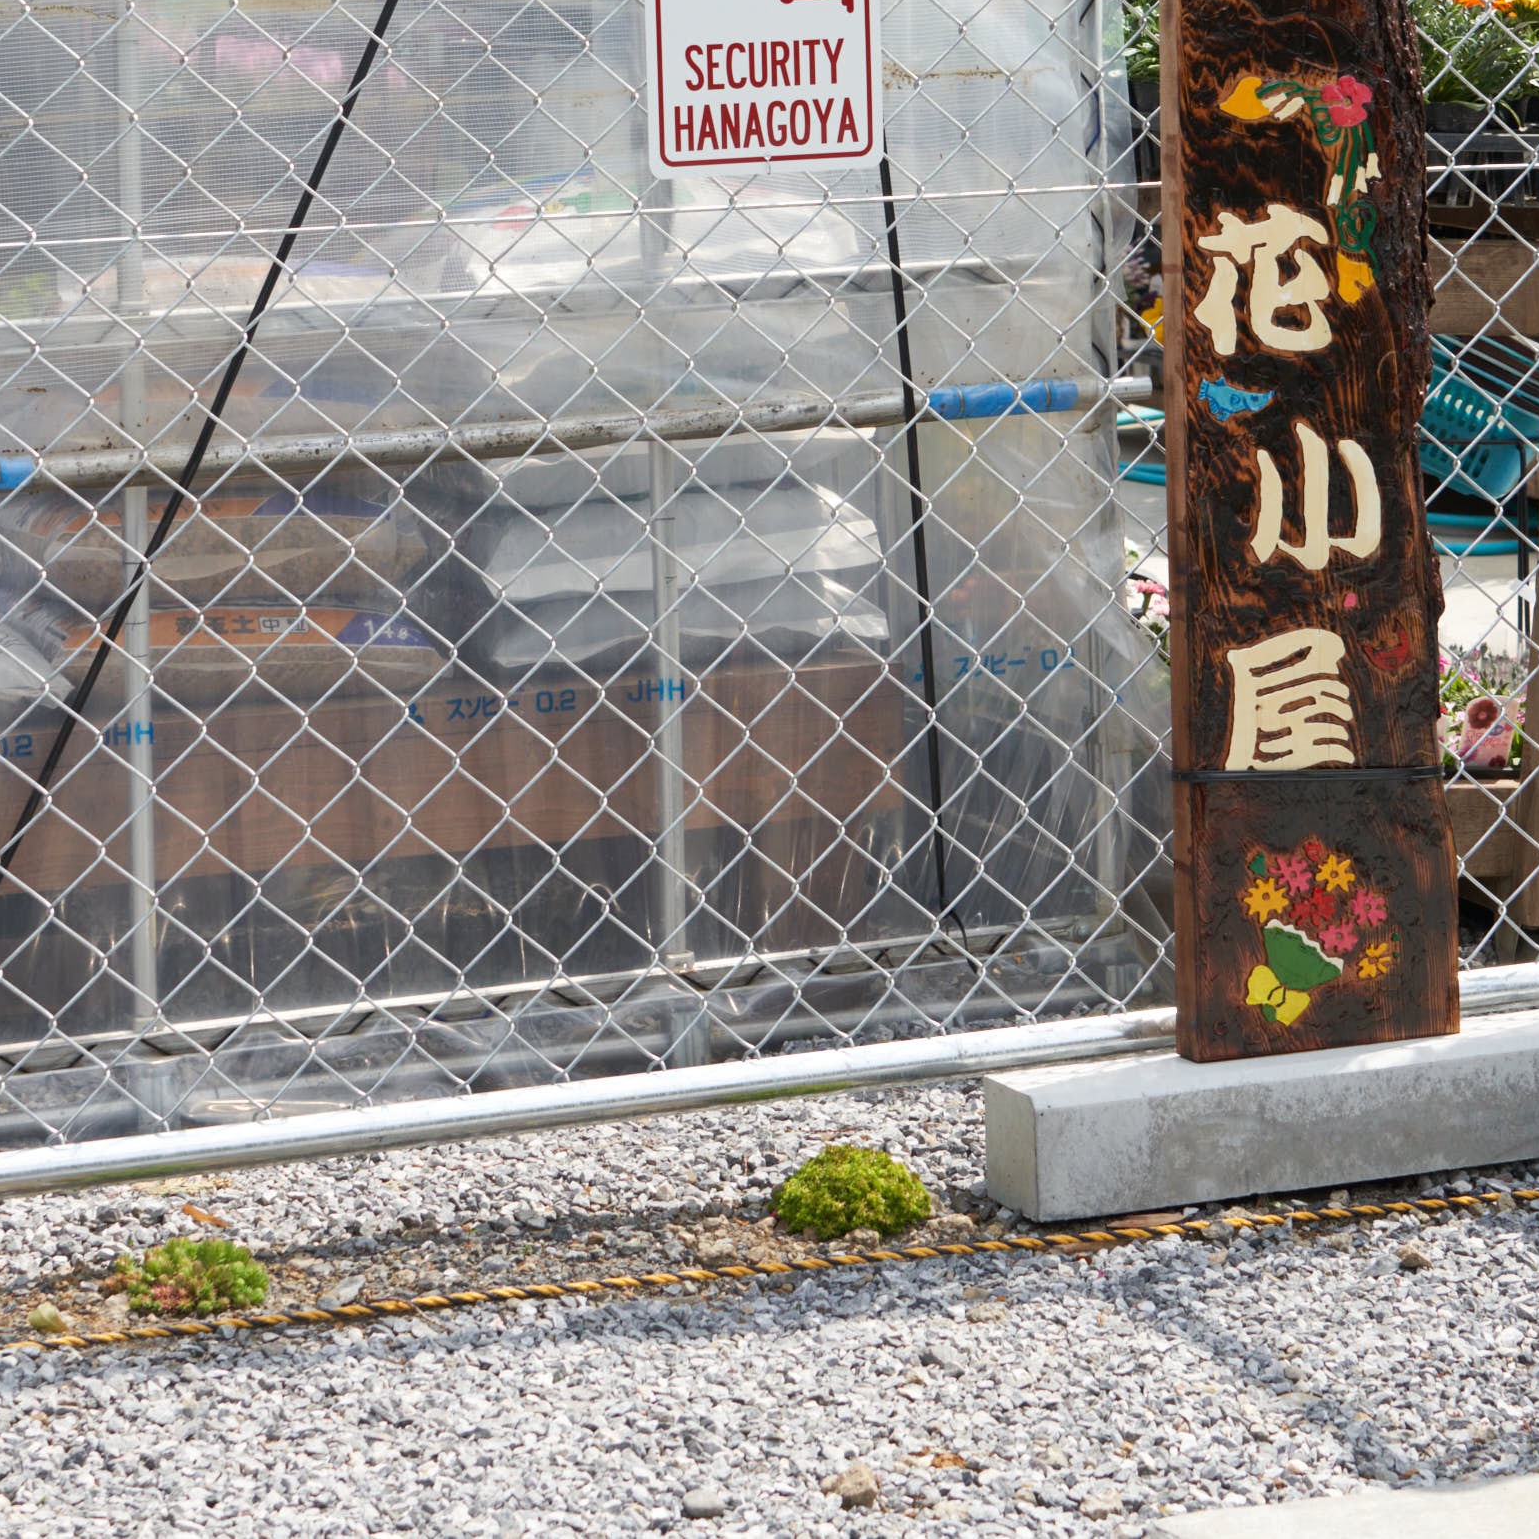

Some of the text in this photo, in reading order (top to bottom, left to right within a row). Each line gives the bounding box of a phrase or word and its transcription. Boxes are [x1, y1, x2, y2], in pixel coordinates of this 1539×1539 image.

[684, 37, 845, 92] SECURITY
[674, 97, 859, 152] HANAGOYA
[1194, 203, 1381, 772] 花小屋
[535, 689, 577, 714] 0.2
[627, 677, 686, 703] JHH
